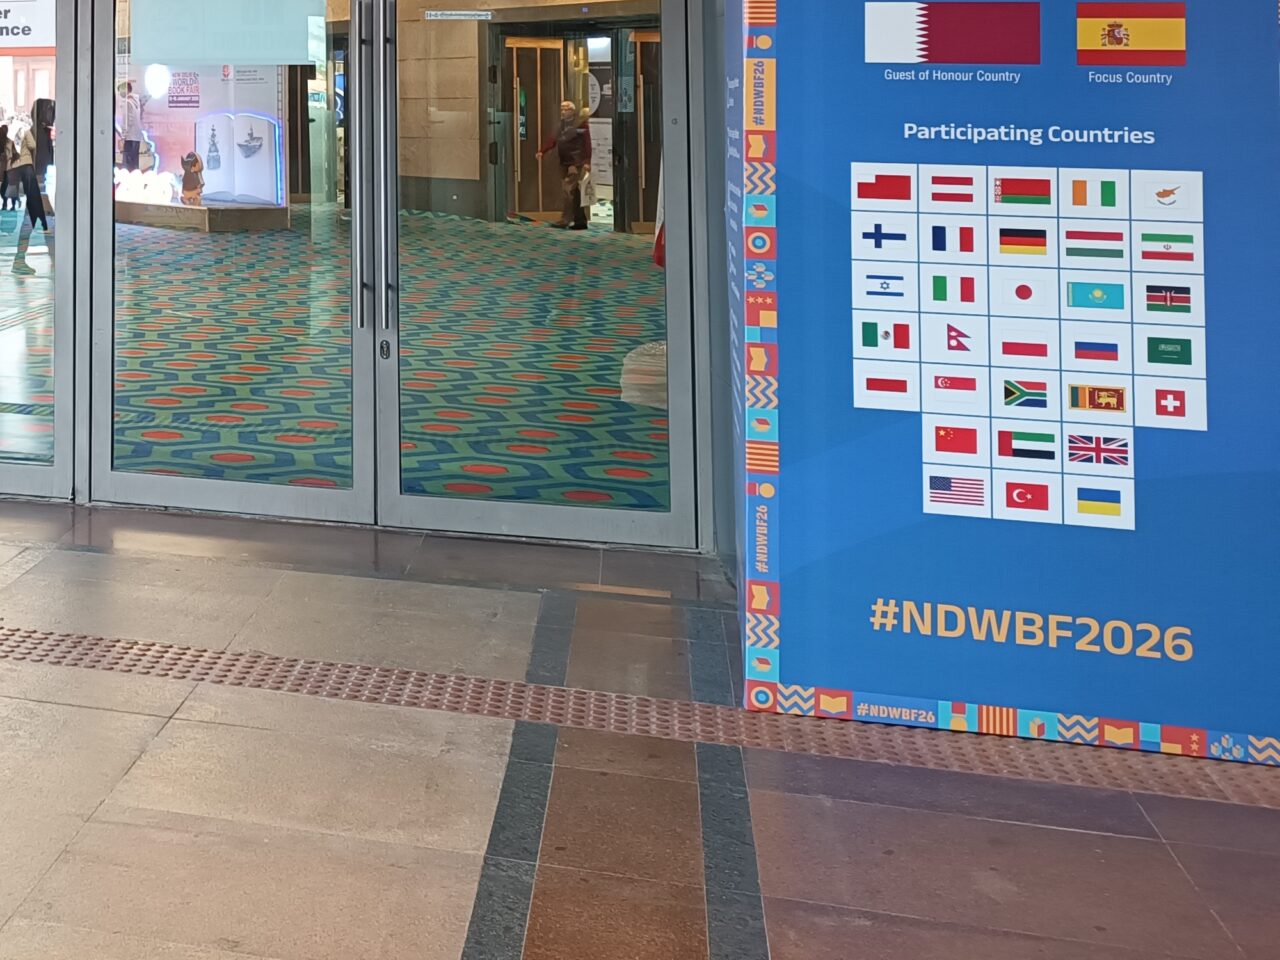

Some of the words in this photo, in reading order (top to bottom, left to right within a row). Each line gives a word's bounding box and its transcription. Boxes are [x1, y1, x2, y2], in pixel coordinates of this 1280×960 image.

[884, 69, 915, 81] Guest
[918, 69, 930, 81] of
[932, 70, 973, 82] Honour
[976, 71, 1021, 83] Country
[1088, 71, 1123, 84] Focus
[1126, 72, 1172, 86] Country
[752, 61, 765, 126] #NDWBF26
[904, 123, 1043, 145] Participating
[1048, 126, 1155, 144] Countries
[755, 504, 768, 573] #NDWBF26
[869, 597, 1194, 662] #NDWBF2026
[856, 703, 936, 723] #NDWBF26
